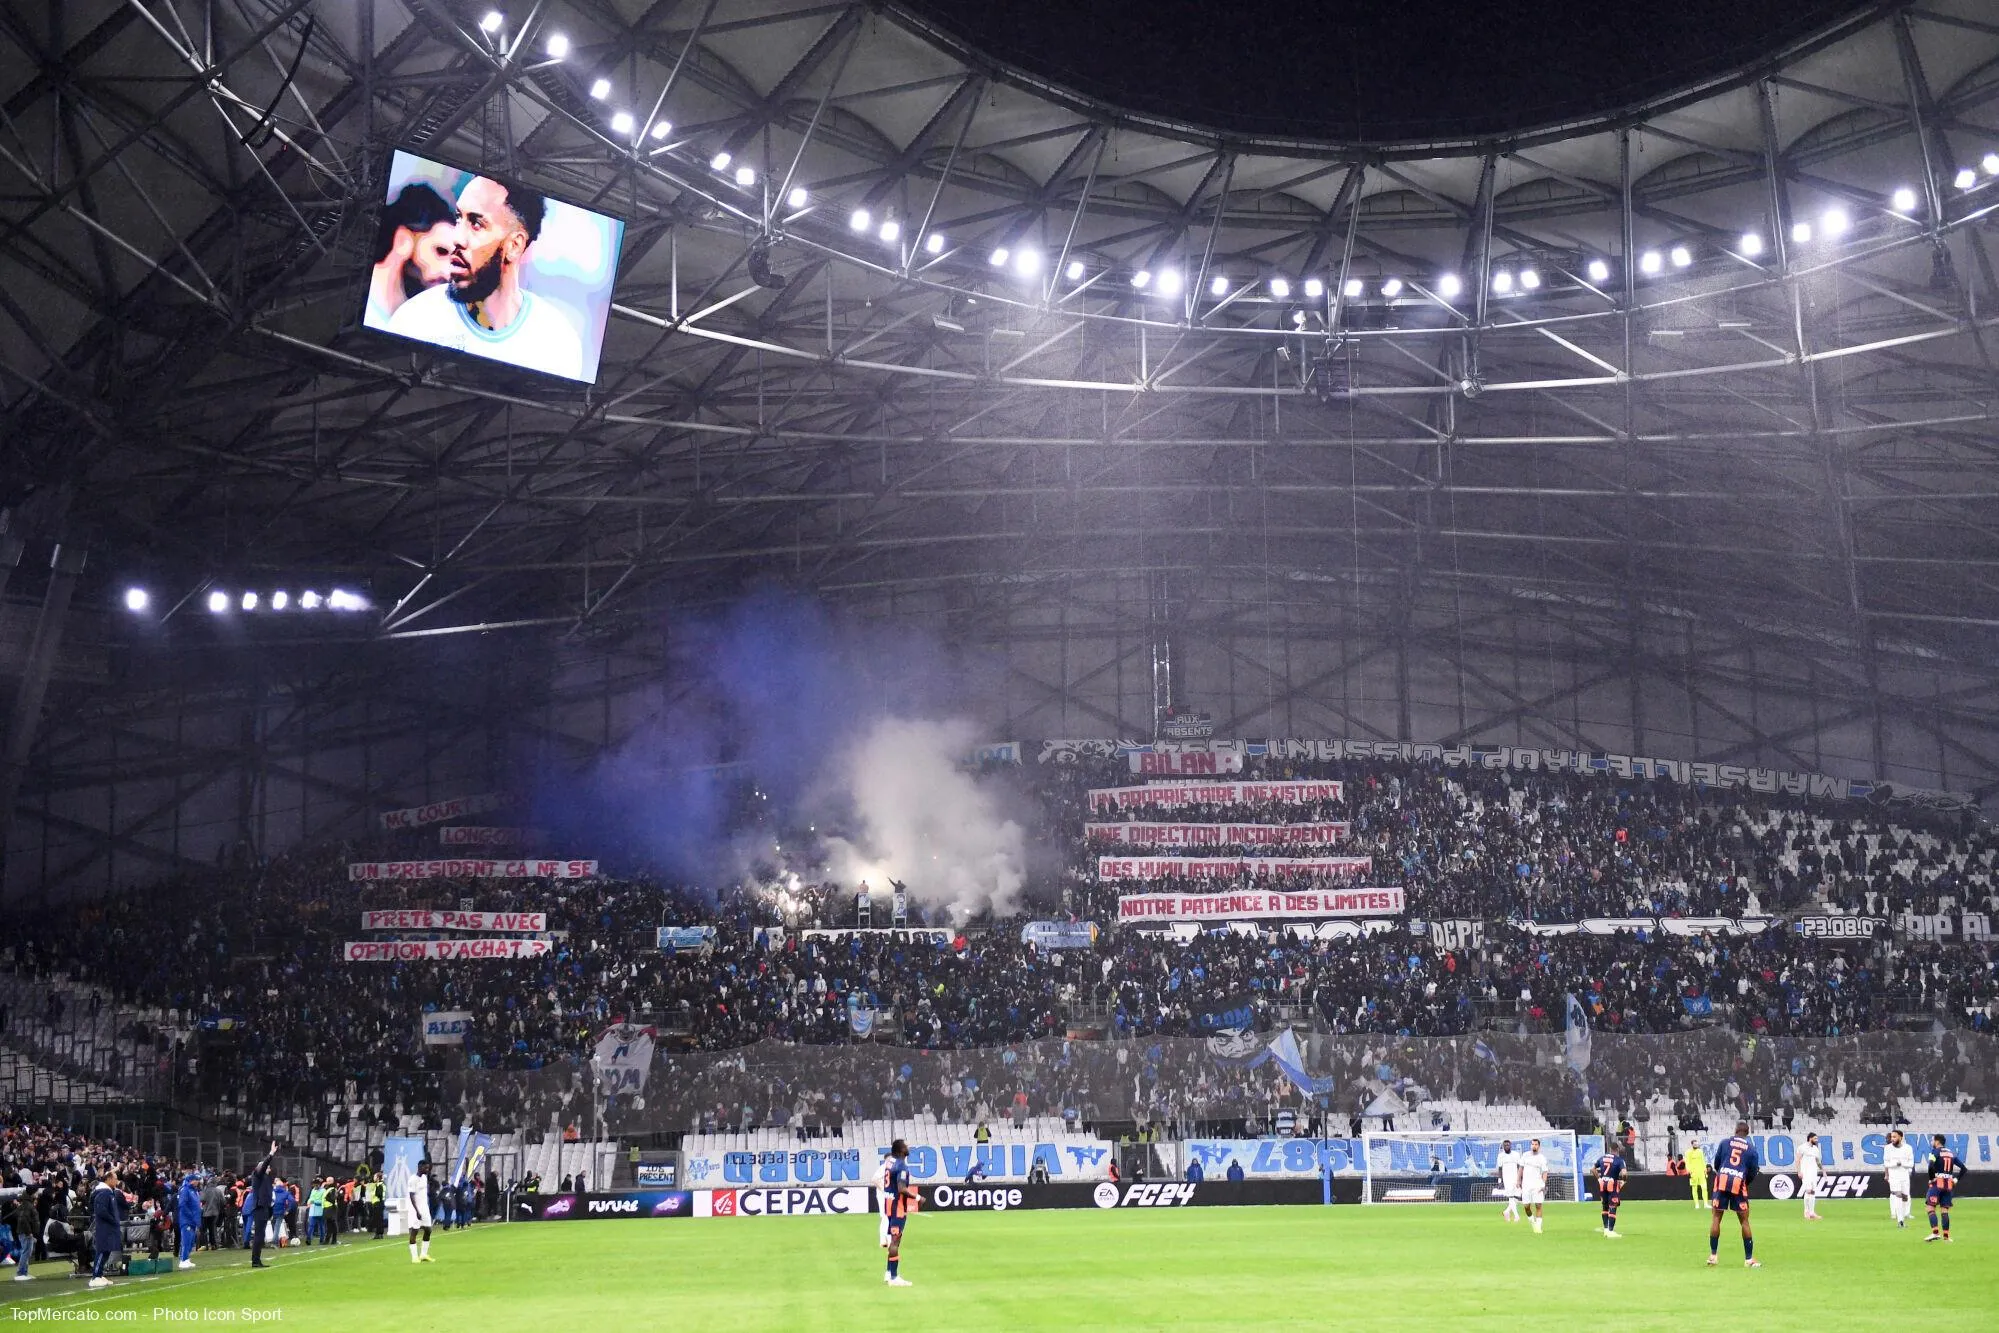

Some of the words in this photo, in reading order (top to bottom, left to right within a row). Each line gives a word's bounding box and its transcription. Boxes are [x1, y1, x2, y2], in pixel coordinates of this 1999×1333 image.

[1167, 726, 1213, 736] ABSENTS
[1140, 752, 1217, 773] BILAN
[1483, 747, 1597, 776] TROP
[1606, 753, 1850, 800] MARSEILLE
[1242, 785, 1339, 801] INEXISTANT
[1088, 827, 1122, 842] UNE
[1129, 825, 1220, 842] DIRECTION
[1227, 825, 1345, 844] INCOHERENTE
[353, 863, 379, 879] UN
[387, 860, 498, 878] PRESIDENT
[506, 861, 527, 876] CA
[538, 861, 559, 877] NE
[567, 861, 593, 877] SE
[1101, 862, 1133, 878] DES
[1121, 899, 1176, 917] NOTRE
[1181, 895, 1264, 915] PATIENCE
[1268, 895, 1281, 911] A
[1285, 895, 1319, 911] DES
[1324, 893, 1390, 911] LIMITES
[369, 911, 433, 928] PRETE
[443, 912, 483, 929] PAS
[492, 913, 541, 930] AVEC
[1803, 918, 1885, 937] 23.08.0
[350, 943, 427, 960] OPTION
[436, 941, 523, 960] D'ACHAT
[427, 1020, 471, 1035] ALE
[790, 1153, 814, 1164] DE
[815, 1151, 860, 1162] Patrice
[1729, 1148, 1742, 1167] 5
[1861, 1132, 1970, 1168] AMS
[723, 1149, 860, 1183] NORD
[1603, 1162, 1611, 1176] 7
[1943, 1157, 1952, 1172] 11
[1100, 1188, 1114, 1197] EA
[1774, 1180, 1789, 1189] EA
[739, 1187, 850, 1215] CEPAC
[934, 1185, 1022, 1211] Orange
